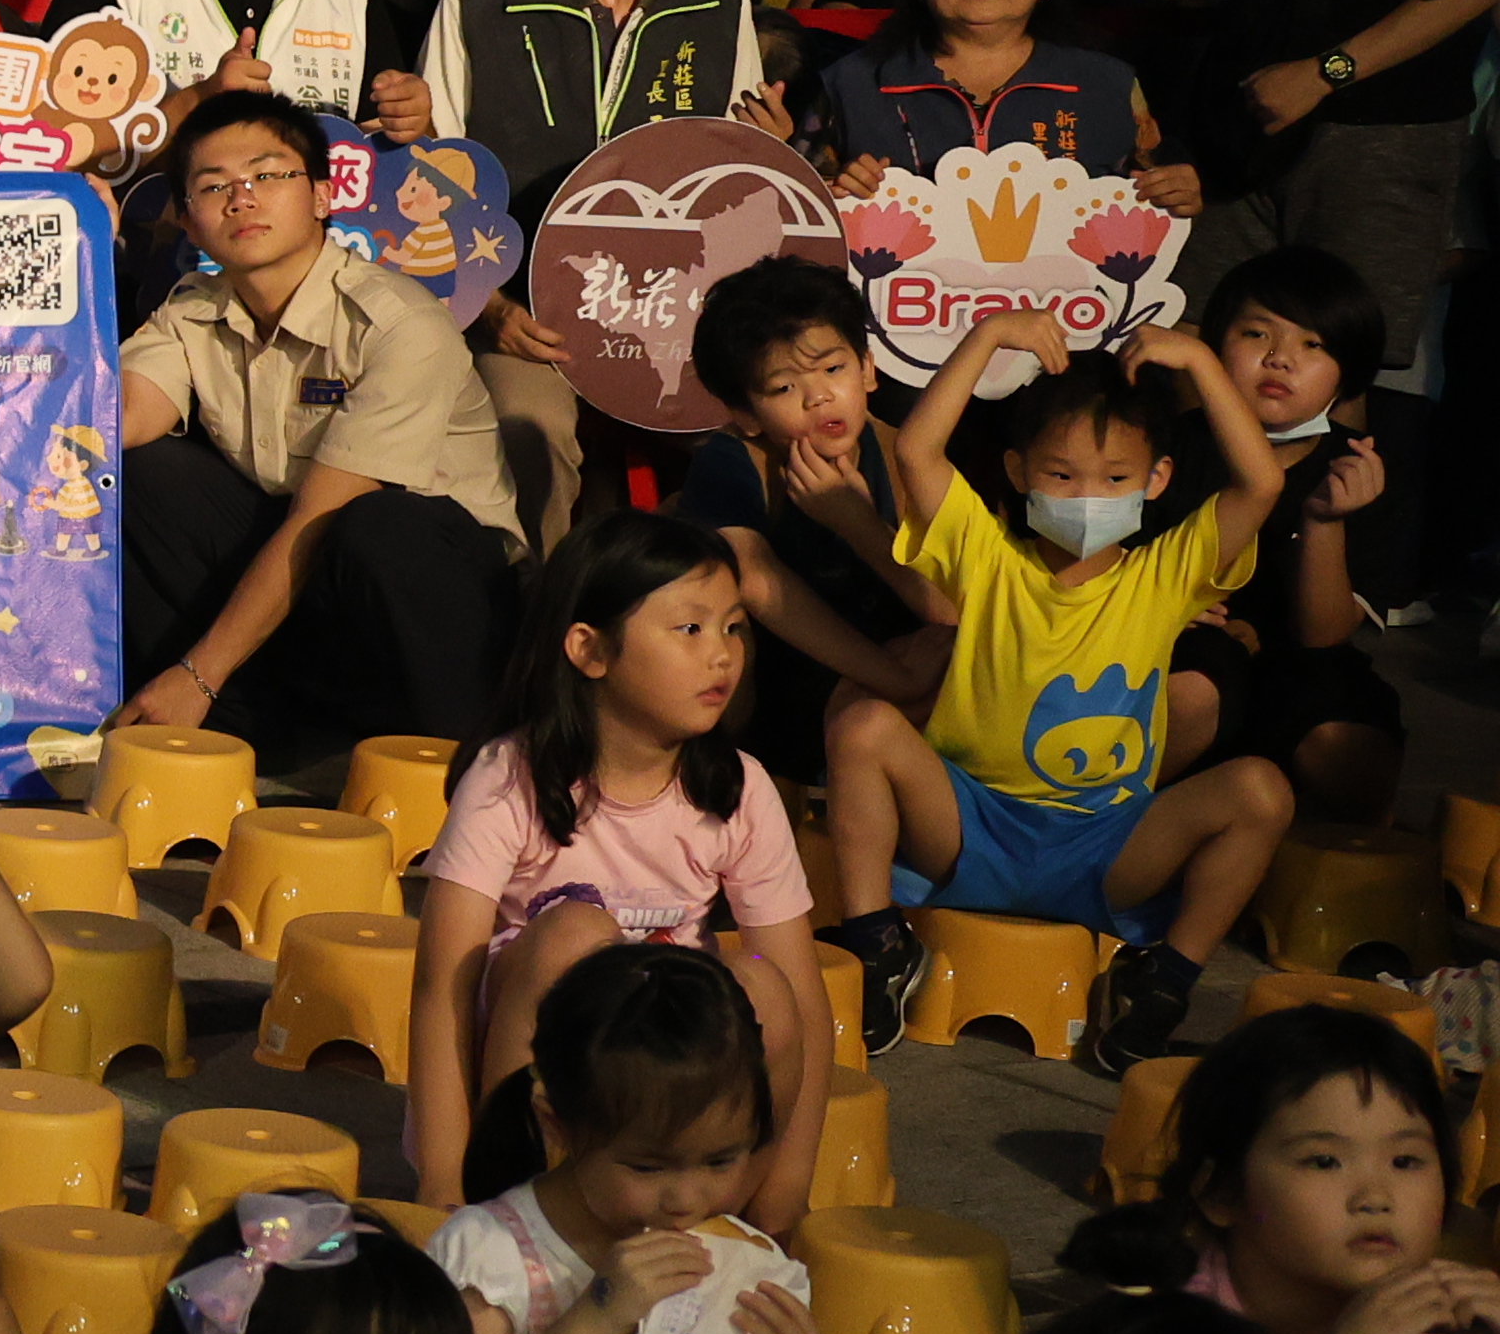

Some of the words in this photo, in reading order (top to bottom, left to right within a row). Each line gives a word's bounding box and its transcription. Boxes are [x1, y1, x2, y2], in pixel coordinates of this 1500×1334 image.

[672, 40, 698, 111] 新莊區
[577, 257, 704, 329] 新莊
[886, 278, 1106, 331] Bravo
[597, 338, 643, 361] Xin
